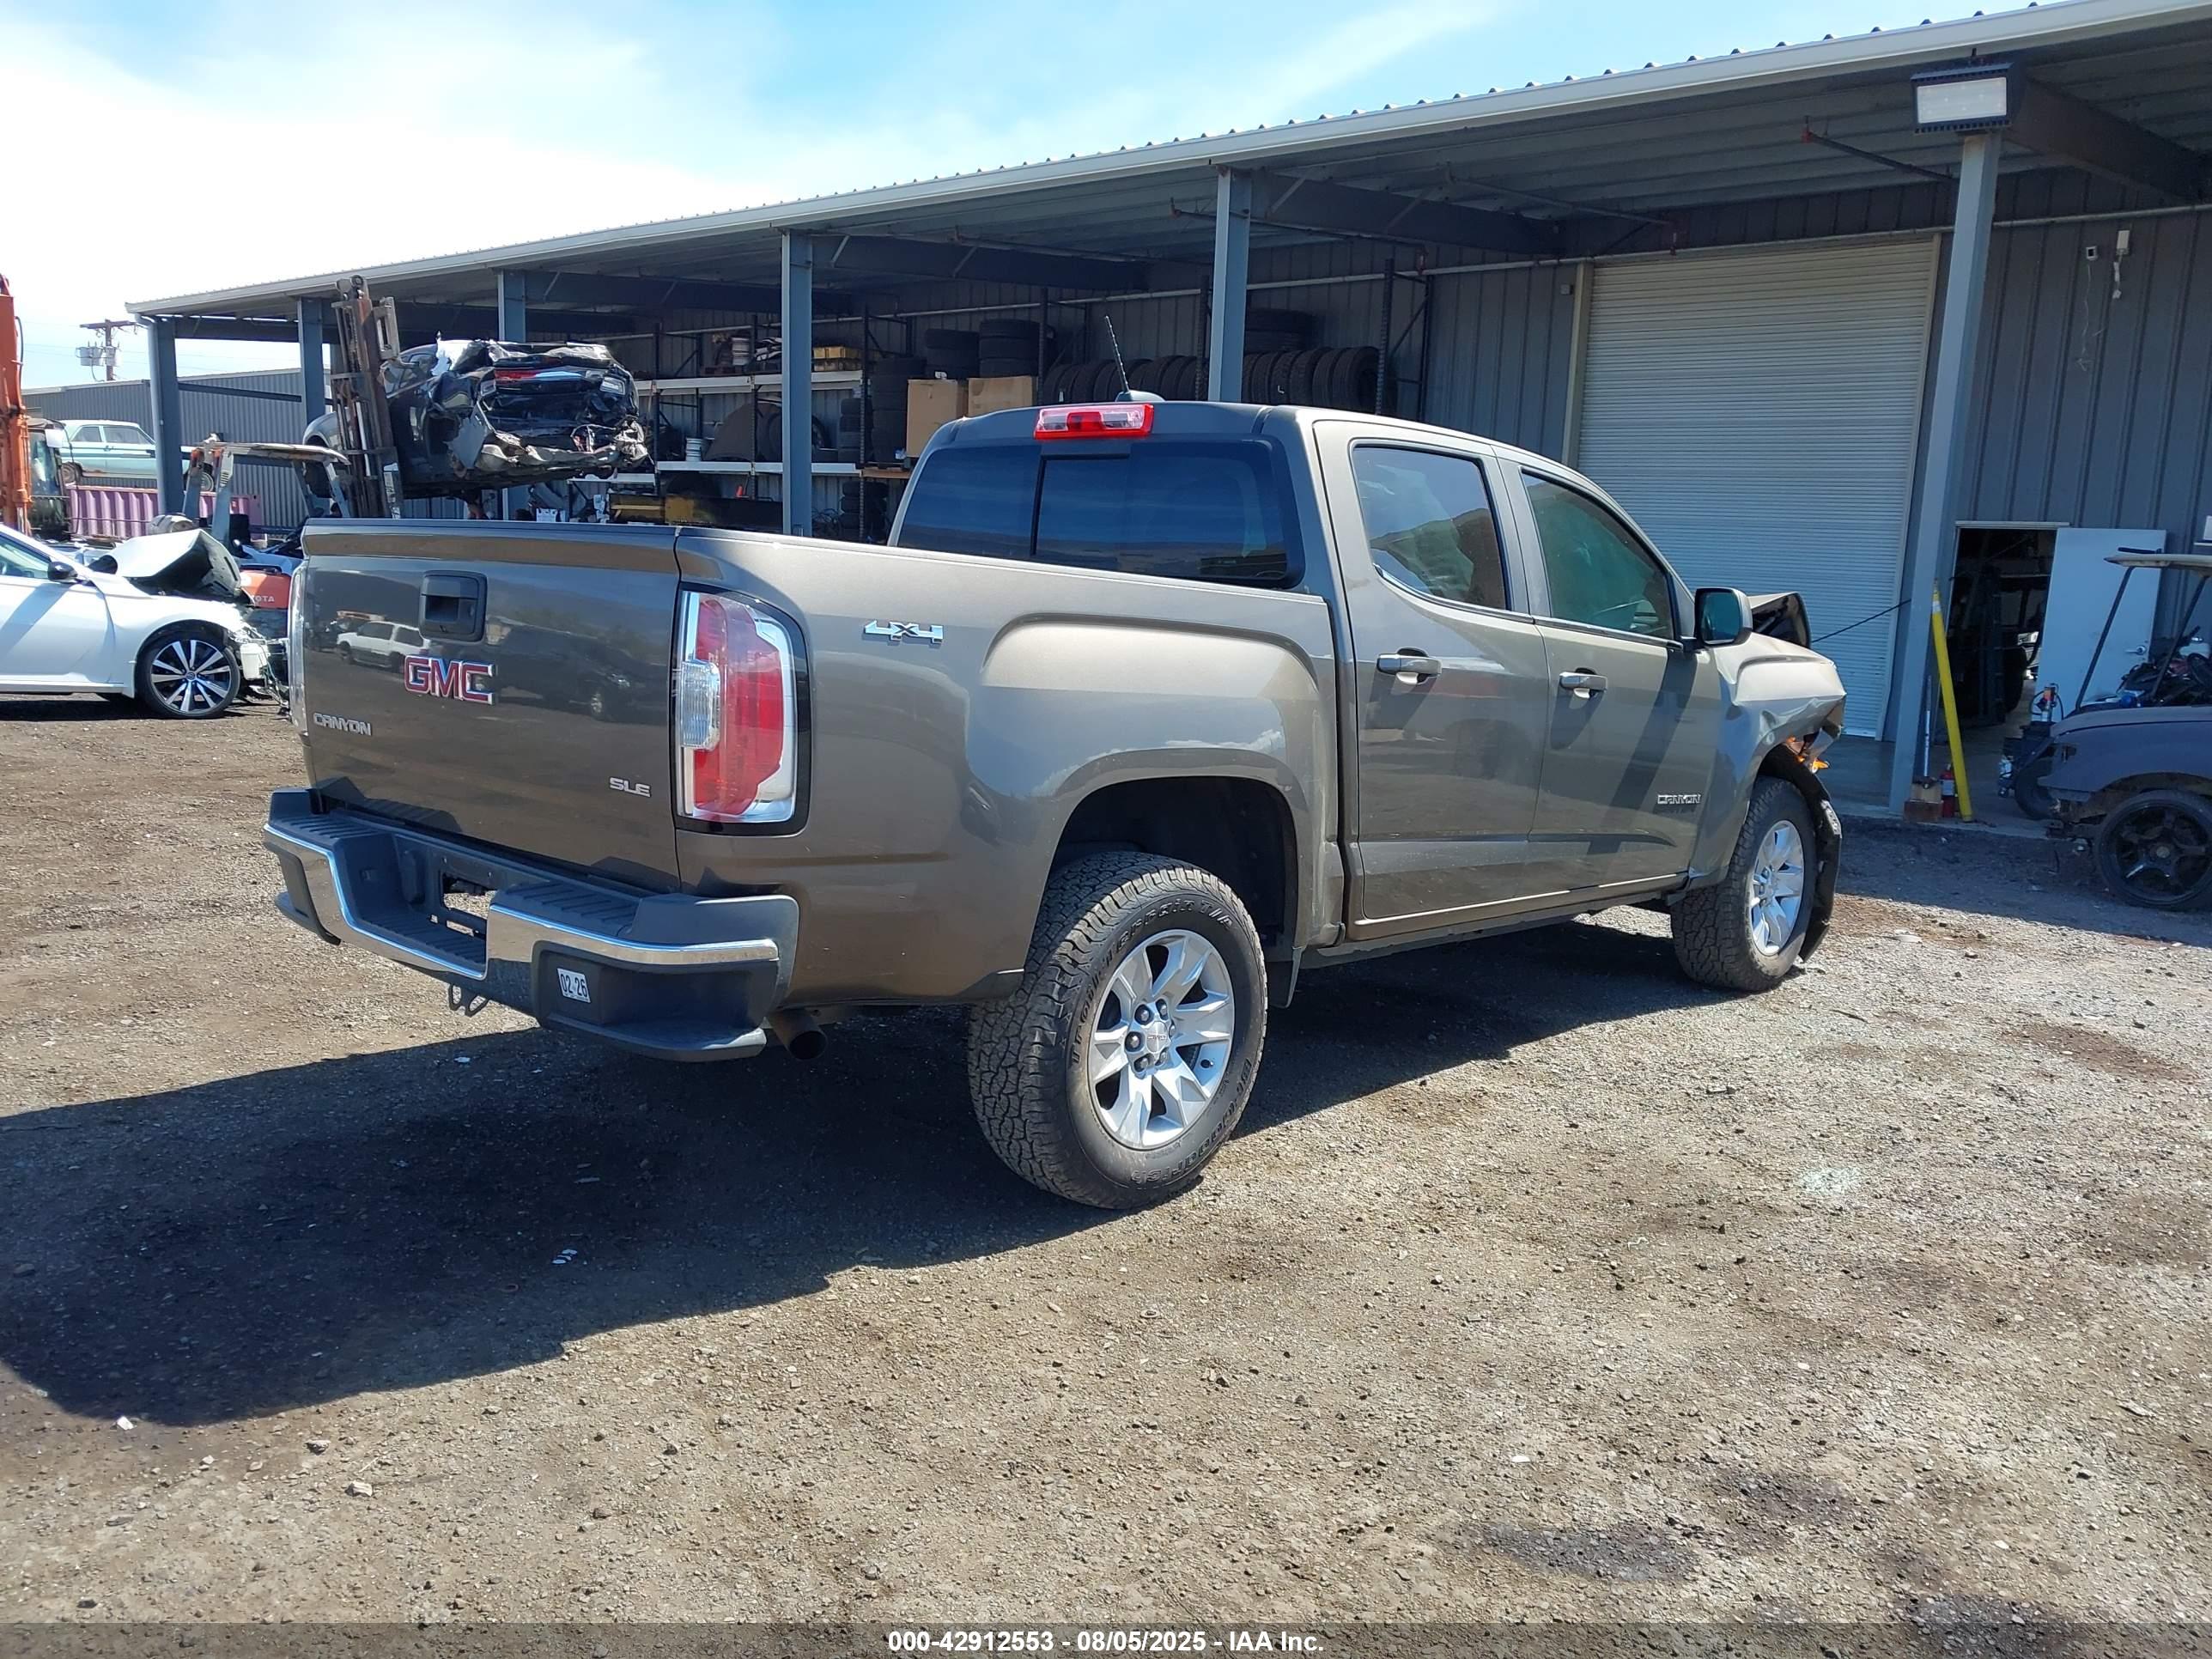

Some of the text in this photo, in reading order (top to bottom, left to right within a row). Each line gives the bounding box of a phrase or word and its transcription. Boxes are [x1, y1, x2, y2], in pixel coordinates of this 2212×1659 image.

[404, 654, 495, 705] GMC
[313, 713, 372, 737] CANYON
[609, 777, 651, 798] SLE
[1657, 793, 1702, 805] CANYON
